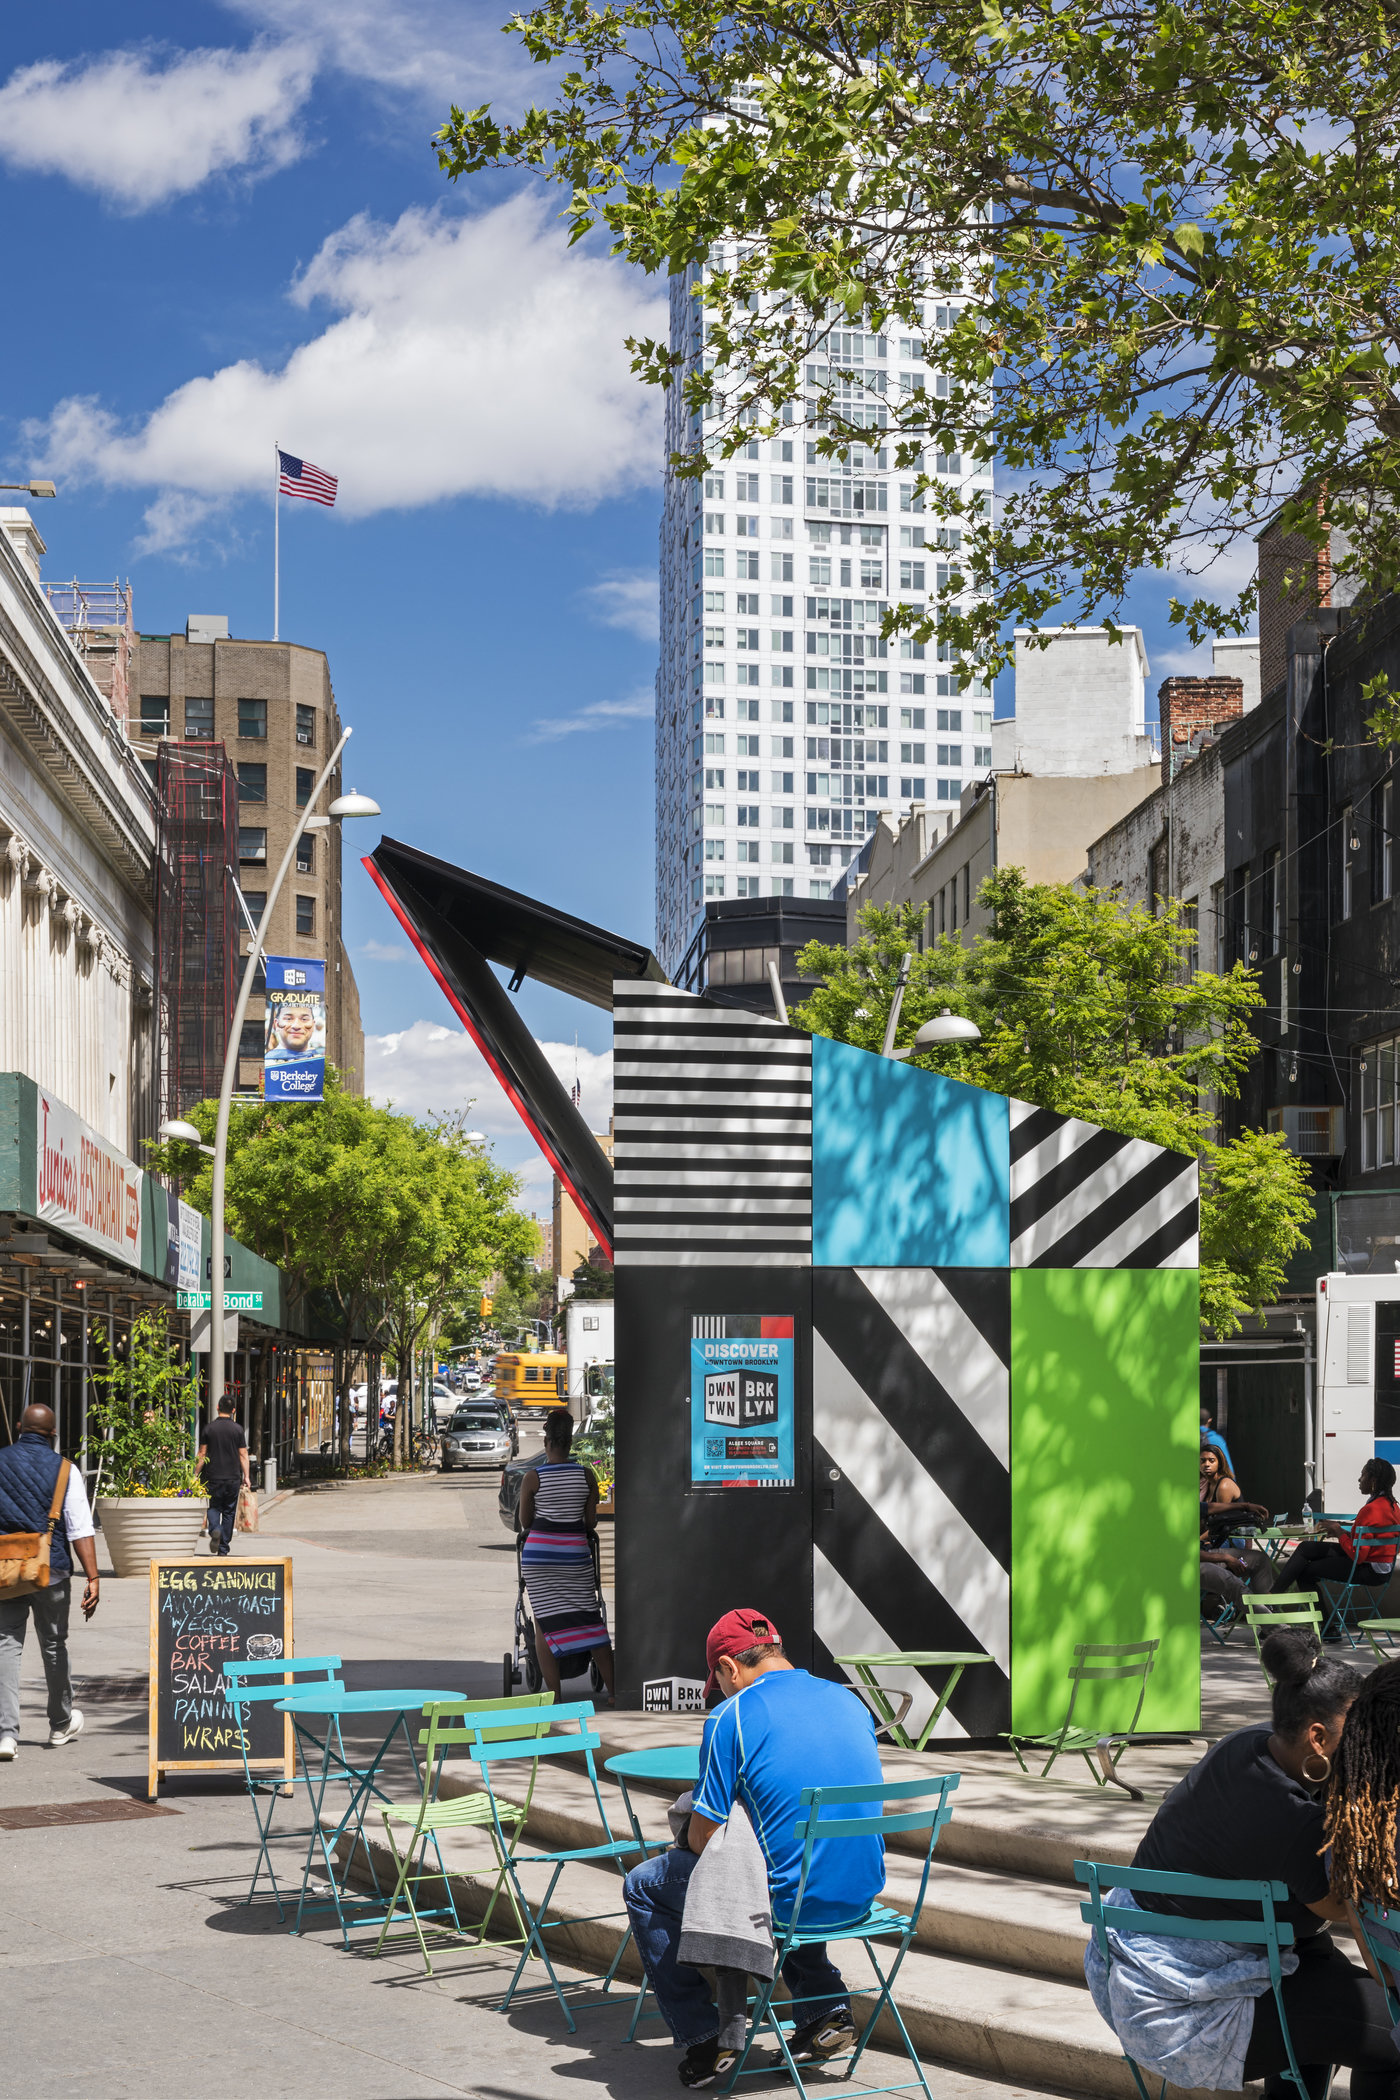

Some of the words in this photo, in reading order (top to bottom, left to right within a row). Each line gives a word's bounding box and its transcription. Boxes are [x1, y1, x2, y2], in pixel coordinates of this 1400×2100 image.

[270, 992, 320, 1004] GRADUATE
[280, 1070, 318, 1083] Berkeley
[281, 1080, 315, 1092] College
[39, 1098, 77, 1216] Junior's
[78, 1135, 124, 1244] RESTAURANT
[177, 1293, 204, 1307] Dekalb
[223, 1293, 253, 1308] Bond
[704, 1343, 779, 1358] DISCOVER
[708, 1380, 735, 1397] DWN
[745, 1380, 774, 1397] BRK
[708, 1401, 735, 1417] TWN
[745, 1400, 774, 1418] LYN
[159, 1570, 198, 1592] EGG
[201, 1570, 276, 1591] SANDWICH
[232, 1594, 281, 1615] TOAST
[175, 1634, 240, 1651] COFFEE
[170, 1651, 214, 1673] BAR
[646, 1687, 670, 1701] DWN
[678, 1687, 702, 1700] BRK
[174, 1698, 252, 1723] PANINS
[183, 1726, 252, 1751] WRAPS
